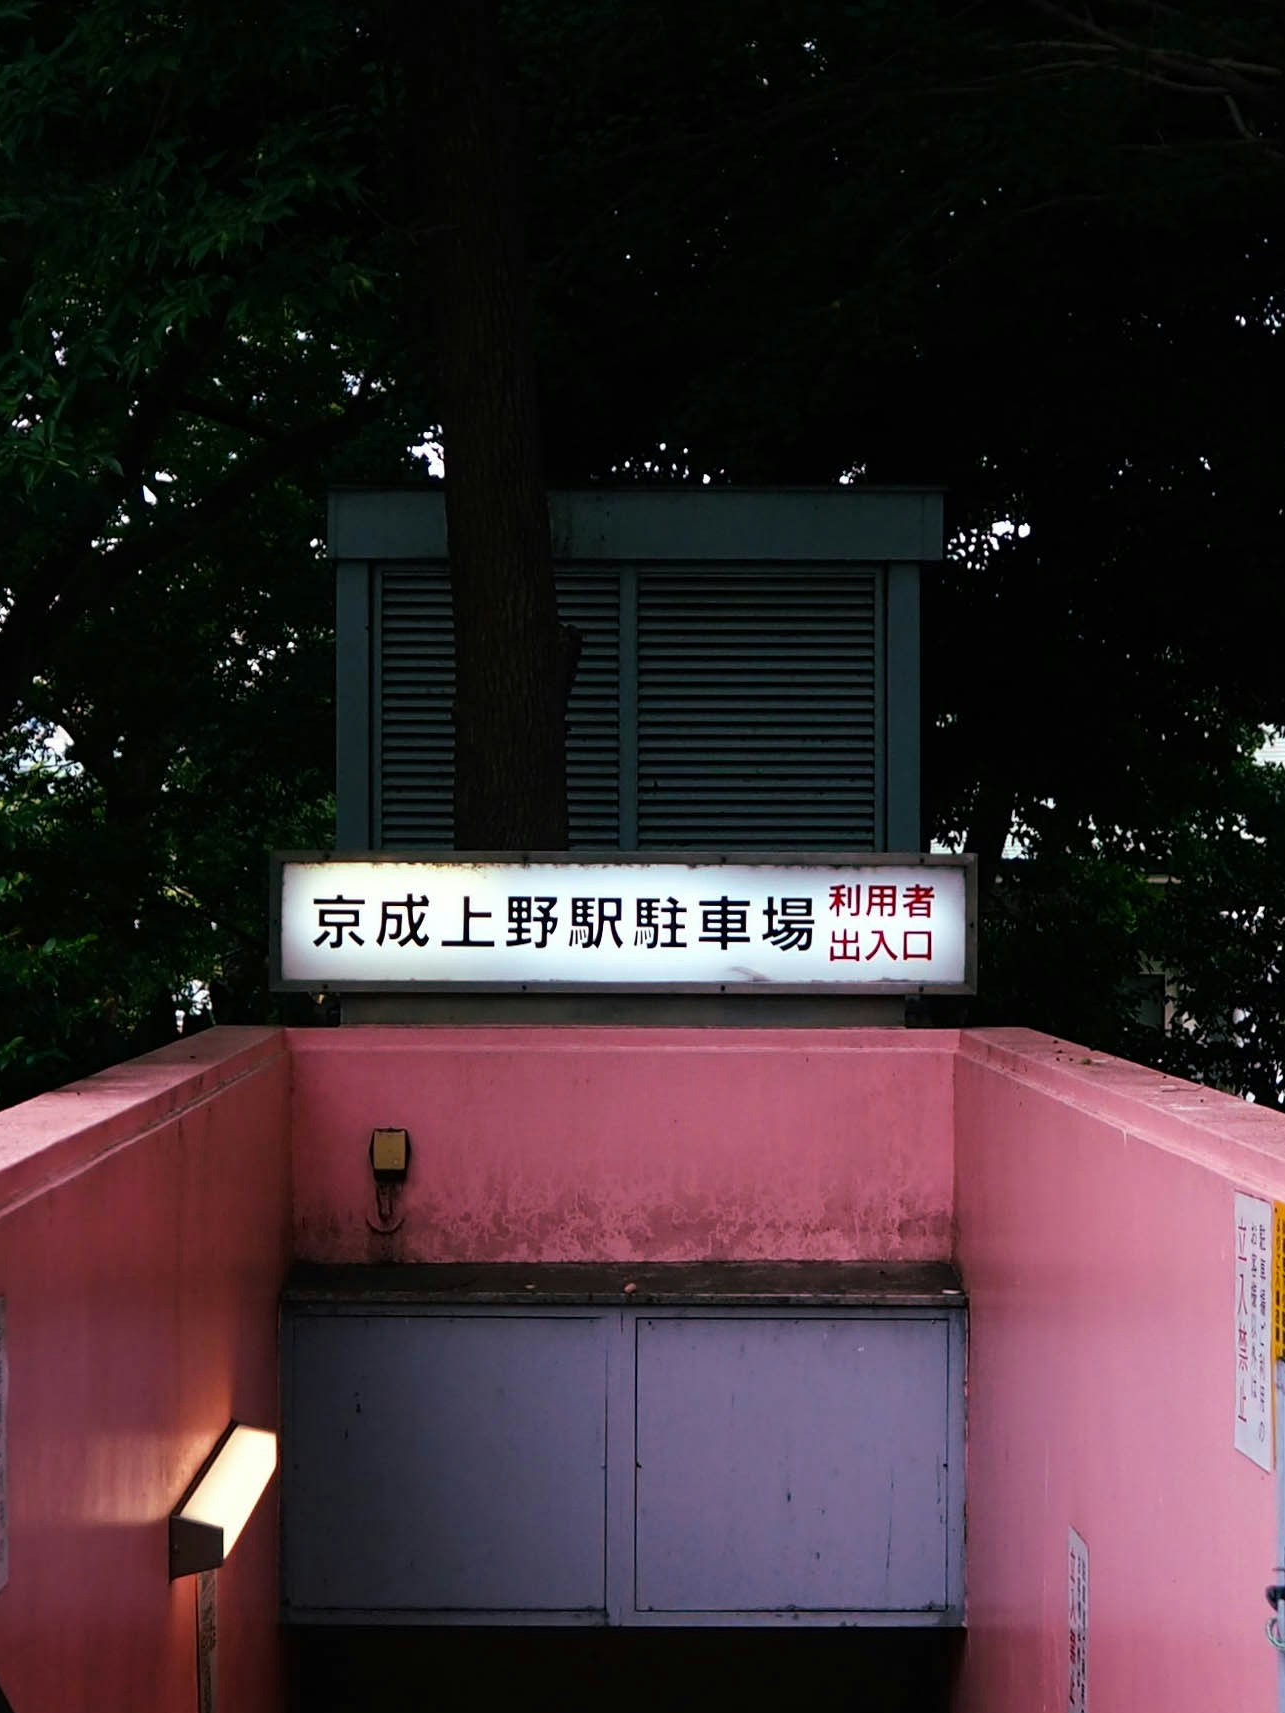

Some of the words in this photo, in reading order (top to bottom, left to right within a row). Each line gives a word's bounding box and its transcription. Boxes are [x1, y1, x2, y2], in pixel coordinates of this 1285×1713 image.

[827, 883, 936, 920] 利用者
[311, 893, 815, 952] 京成上野駅駐車場
[828, 927, 934, 963] 出入口
